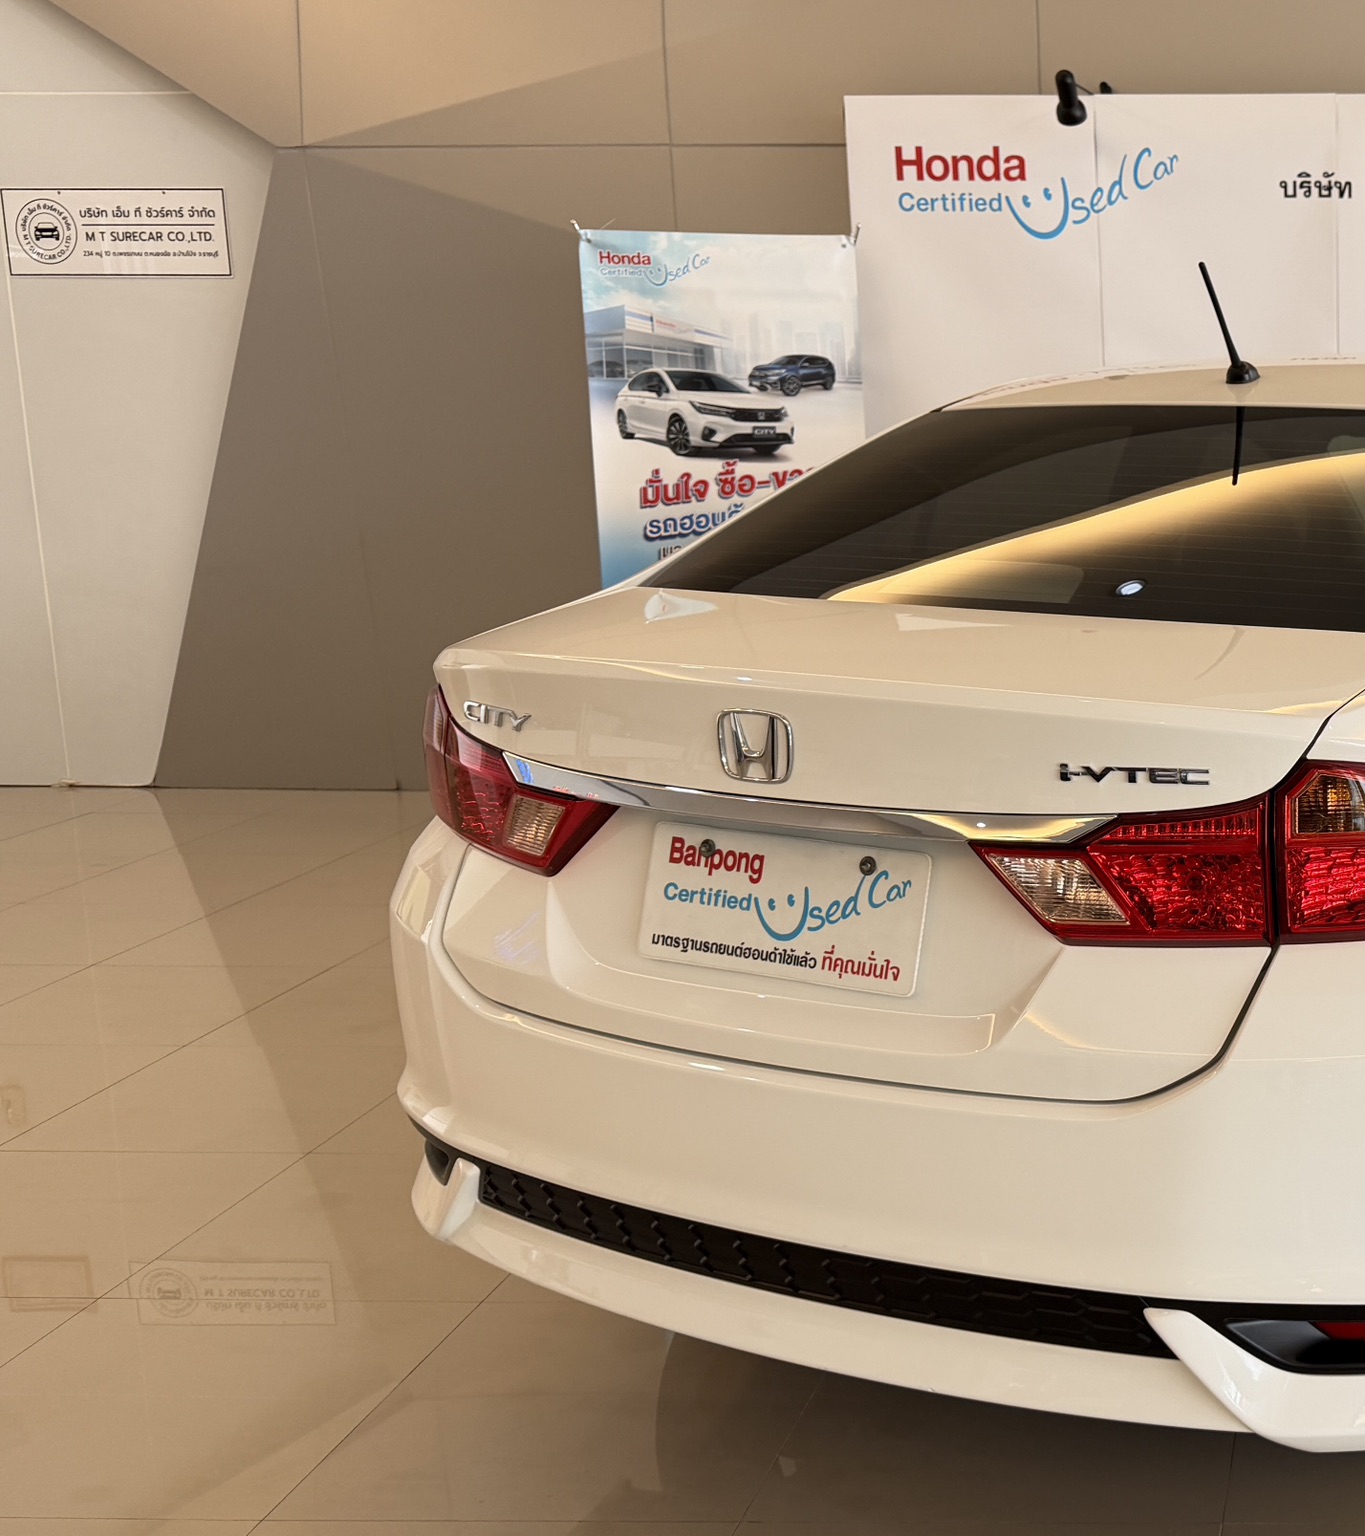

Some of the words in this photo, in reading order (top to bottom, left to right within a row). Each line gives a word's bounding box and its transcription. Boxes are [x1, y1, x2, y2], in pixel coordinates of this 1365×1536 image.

[895, 145, 1027, 182] Honda
[899, 192, 1003, 214] Certified
[1005, 154, 1129, 240] Used
[1134, 147, 1179, 190] Car
[1280, 171, 1352, 198] บริษัท
[79, 207, 108, 218] บริษัท
[112, 205, 130, 218] เอ็ม
[188, 206, 215, 218] จำกัด
[85, 232, 95, 241] M
[99, 232, 106, 241] T
[110, 232, 163, 241] SURECAR
[598, 251, 652, 265] Honda
[600, 268, 643, 276] Certified
[640, 468, 710, 508] มั่นใจ
[463, 700, 532, 732] CITY
[664, 882, 752, 912] Certified
[754, 874, 866, 941] Used
[868, 870, 912, 908] Car
[652, 933, 817, 969] มาตรฐานรถยนต์ฮอนด้าใช้แล้ว
[821, 944, 900, 981] ที่คุณมั่นใจ
